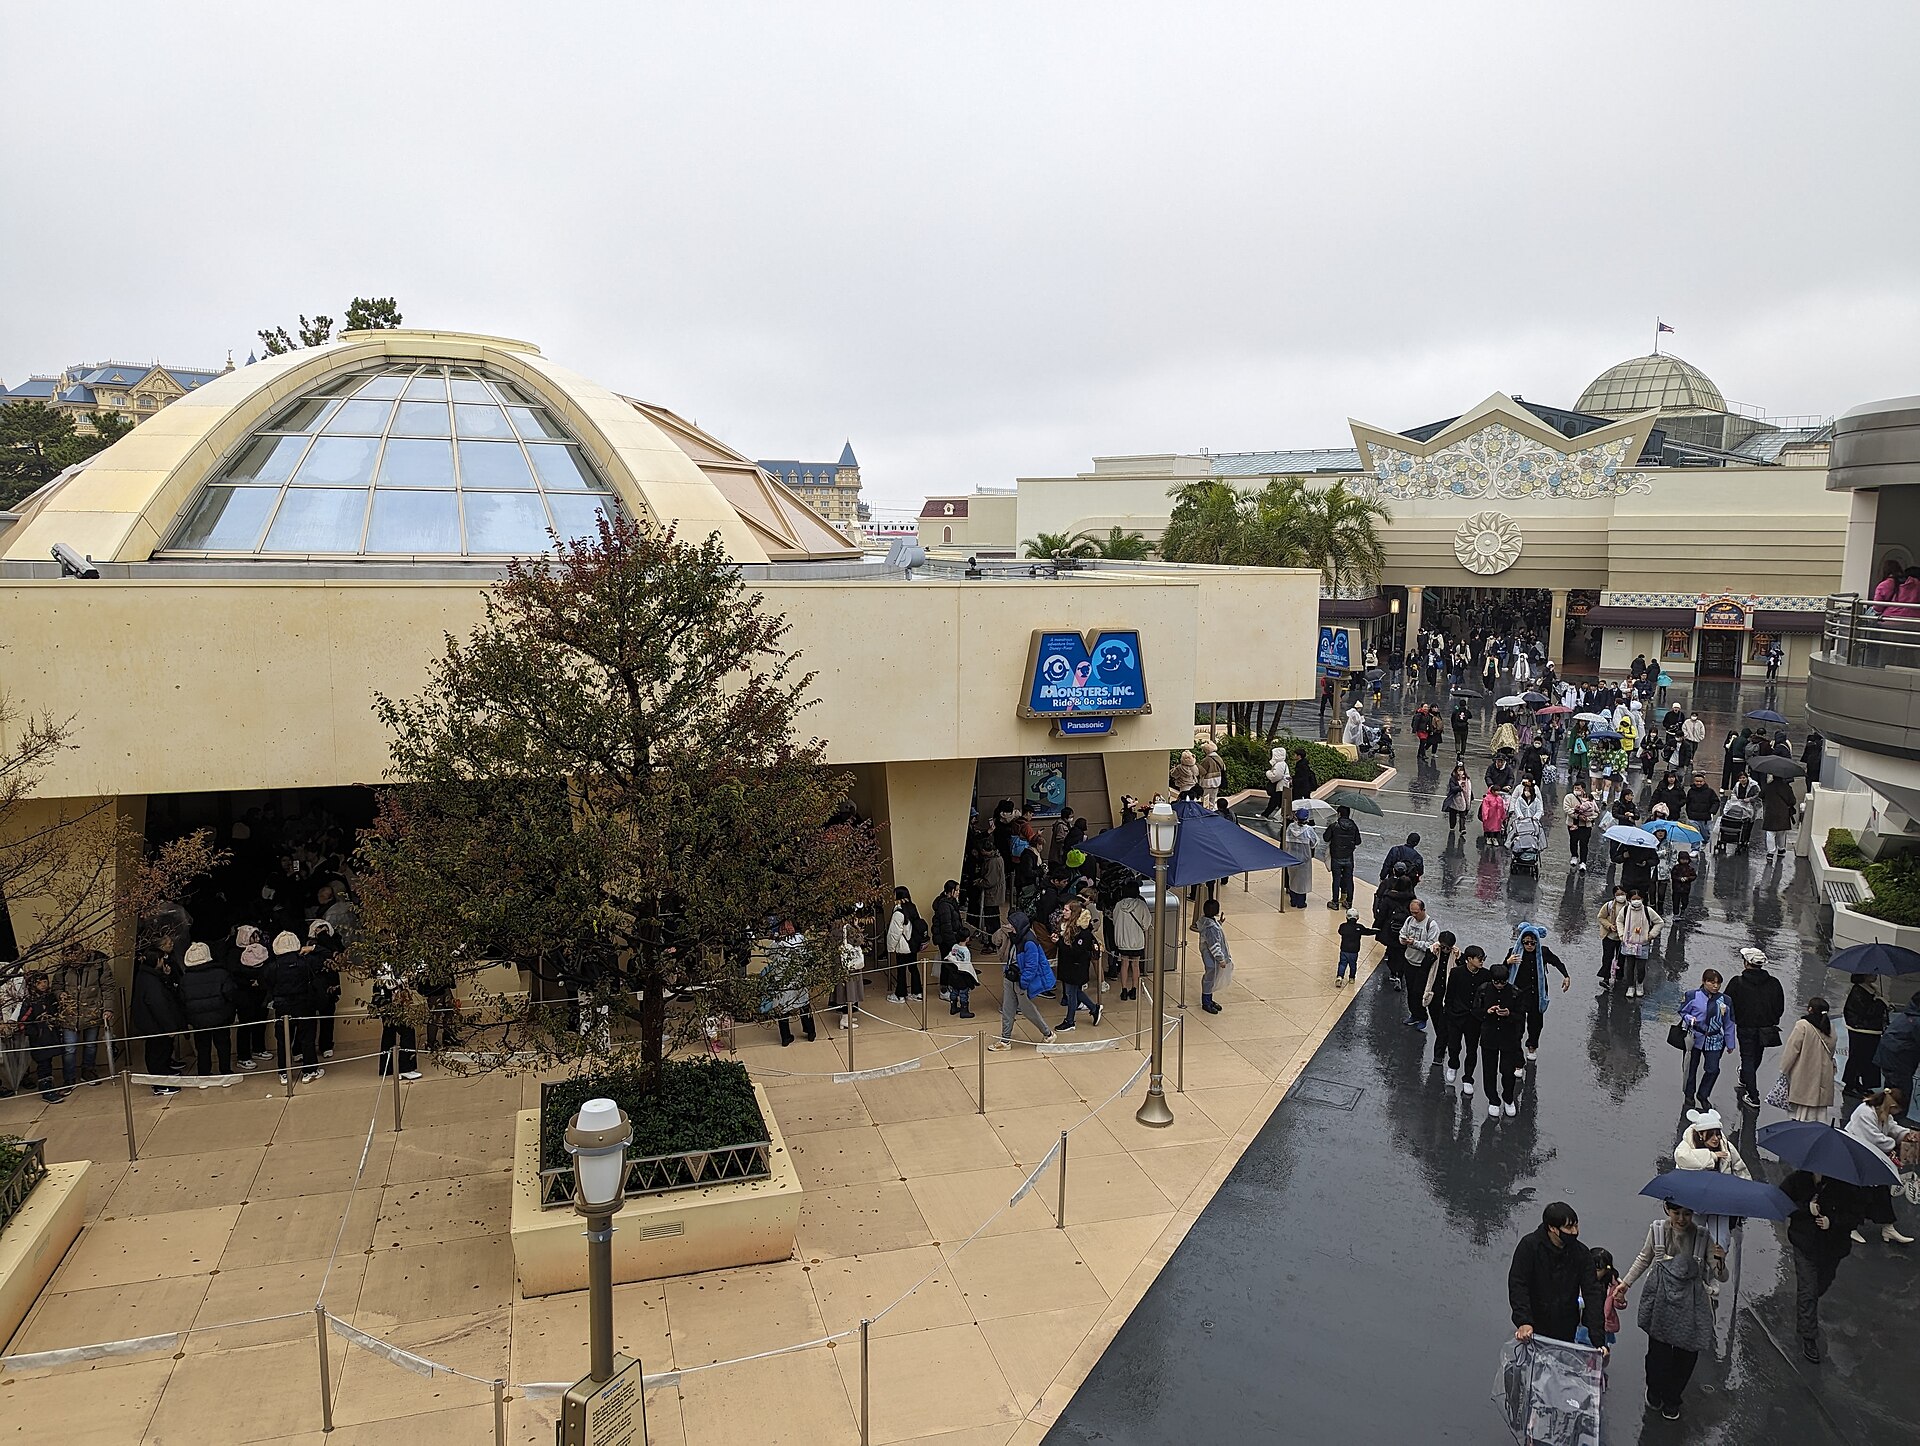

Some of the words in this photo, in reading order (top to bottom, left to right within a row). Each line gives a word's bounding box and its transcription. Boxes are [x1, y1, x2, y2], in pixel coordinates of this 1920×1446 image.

[1040, 685, 1111, 698] MONSTERS,
[1113, 686, 1135, 696] INC.
[1053, 699, 1073, 707] Ride
[1084, 698, 1095, 706] Go
[1097, 698, 1122, 706] Seek!
[1067, 721, 1104, 729] Panasonic
